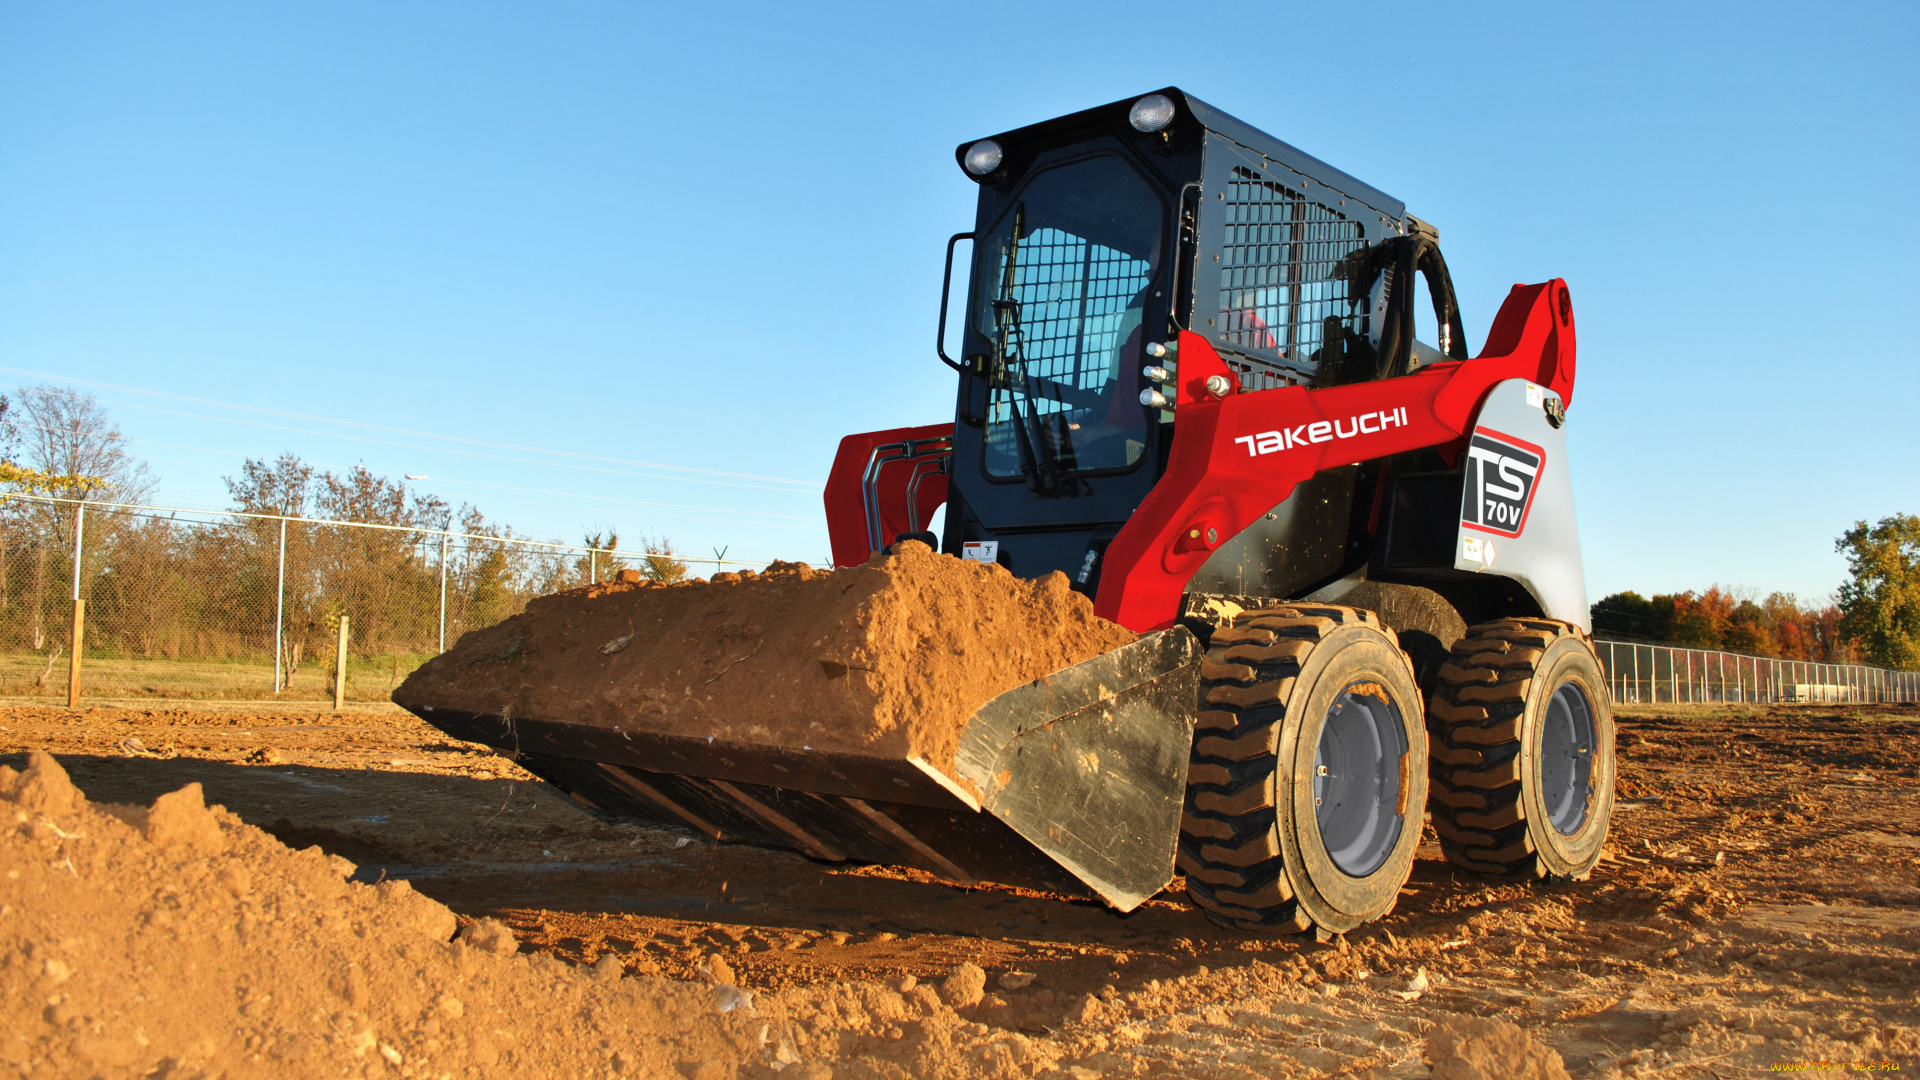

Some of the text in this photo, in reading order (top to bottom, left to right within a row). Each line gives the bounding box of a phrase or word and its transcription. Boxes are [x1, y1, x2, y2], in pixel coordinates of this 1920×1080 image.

[1235, 407, 1408, 457] TAKEUCHI
[1468, 446, 1538, 525] TS
[1486, 500, 1521, 526] 70V
